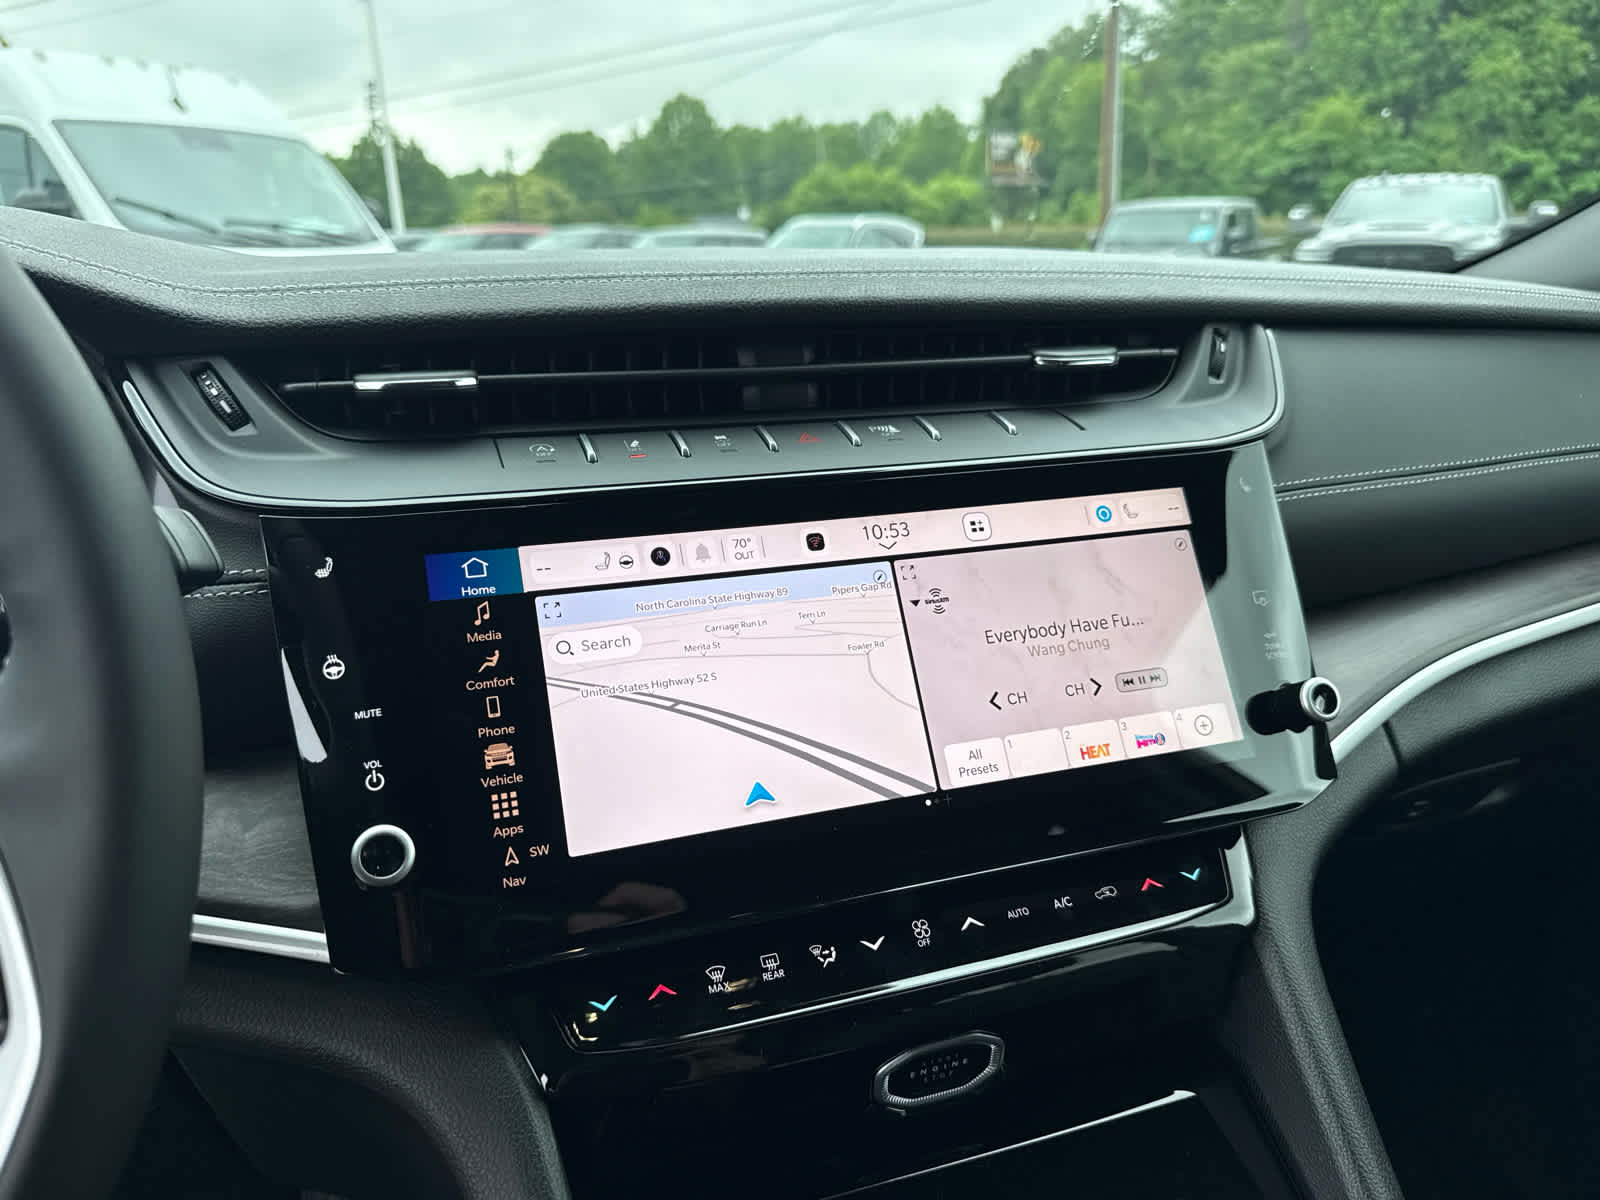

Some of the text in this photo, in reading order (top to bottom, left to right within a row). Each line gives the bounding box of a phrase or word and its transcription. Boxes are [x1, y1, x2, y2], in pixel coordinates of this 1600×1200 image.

[861, 522, 911, 541] 10:53
[734, 550, 755, 561] OUT
[461, 584, 496, 596] Home
[831, 581, 893, 597] Pipers Gap Rd
[635, 587, 789, 612] North Carolina State Highway 89
[817, 609, 826, 618] Ln
[704, 618, 768, 634] Carriage Run Ln
[984, 621, 1067, 644] Everybody
[1070, 616, 1108, 633] Have
[466, 630, 502, 642] Media
[581, 635, 632, 651] Search
[711, 641, 721, 650] St
[848, 640, 885, 652] Fowler Rd
[1027, 637, 1111, 658] Wang Chung
[465, 675, 515, 691] Comfort
[580, 672, 717, 699] United States Highway 52 S
[1065, 682, 1086, 697] CH
[1007, 691, 1028, 705] CH
[354, 708, 382, 720] MUTE
[478, 724, 516, 738] Phone
[1120, 721, 1127, 731] 3
[1064, 730, 1071, 740] 2
[968, 749, 983, 761] All
[1080, 743, 1111, 760] HEAT
[364, 760, 382, 769] VOL
[958, 762, 999, 777] Presets
[480, 772, 524, 788] Vehicle
[493, 824, 524, 839] Apps
[529, 844, 550, 857] SW
[503, 875, 527, 889] Nav
[1053, 896, 1073, 910] A/C
[1007, 906, 1030, 919] AUTO
[917, 937, 931, 948] OFF
[762, 968, 785, 982] REAR
[708, 981, 731, 994] MAX
